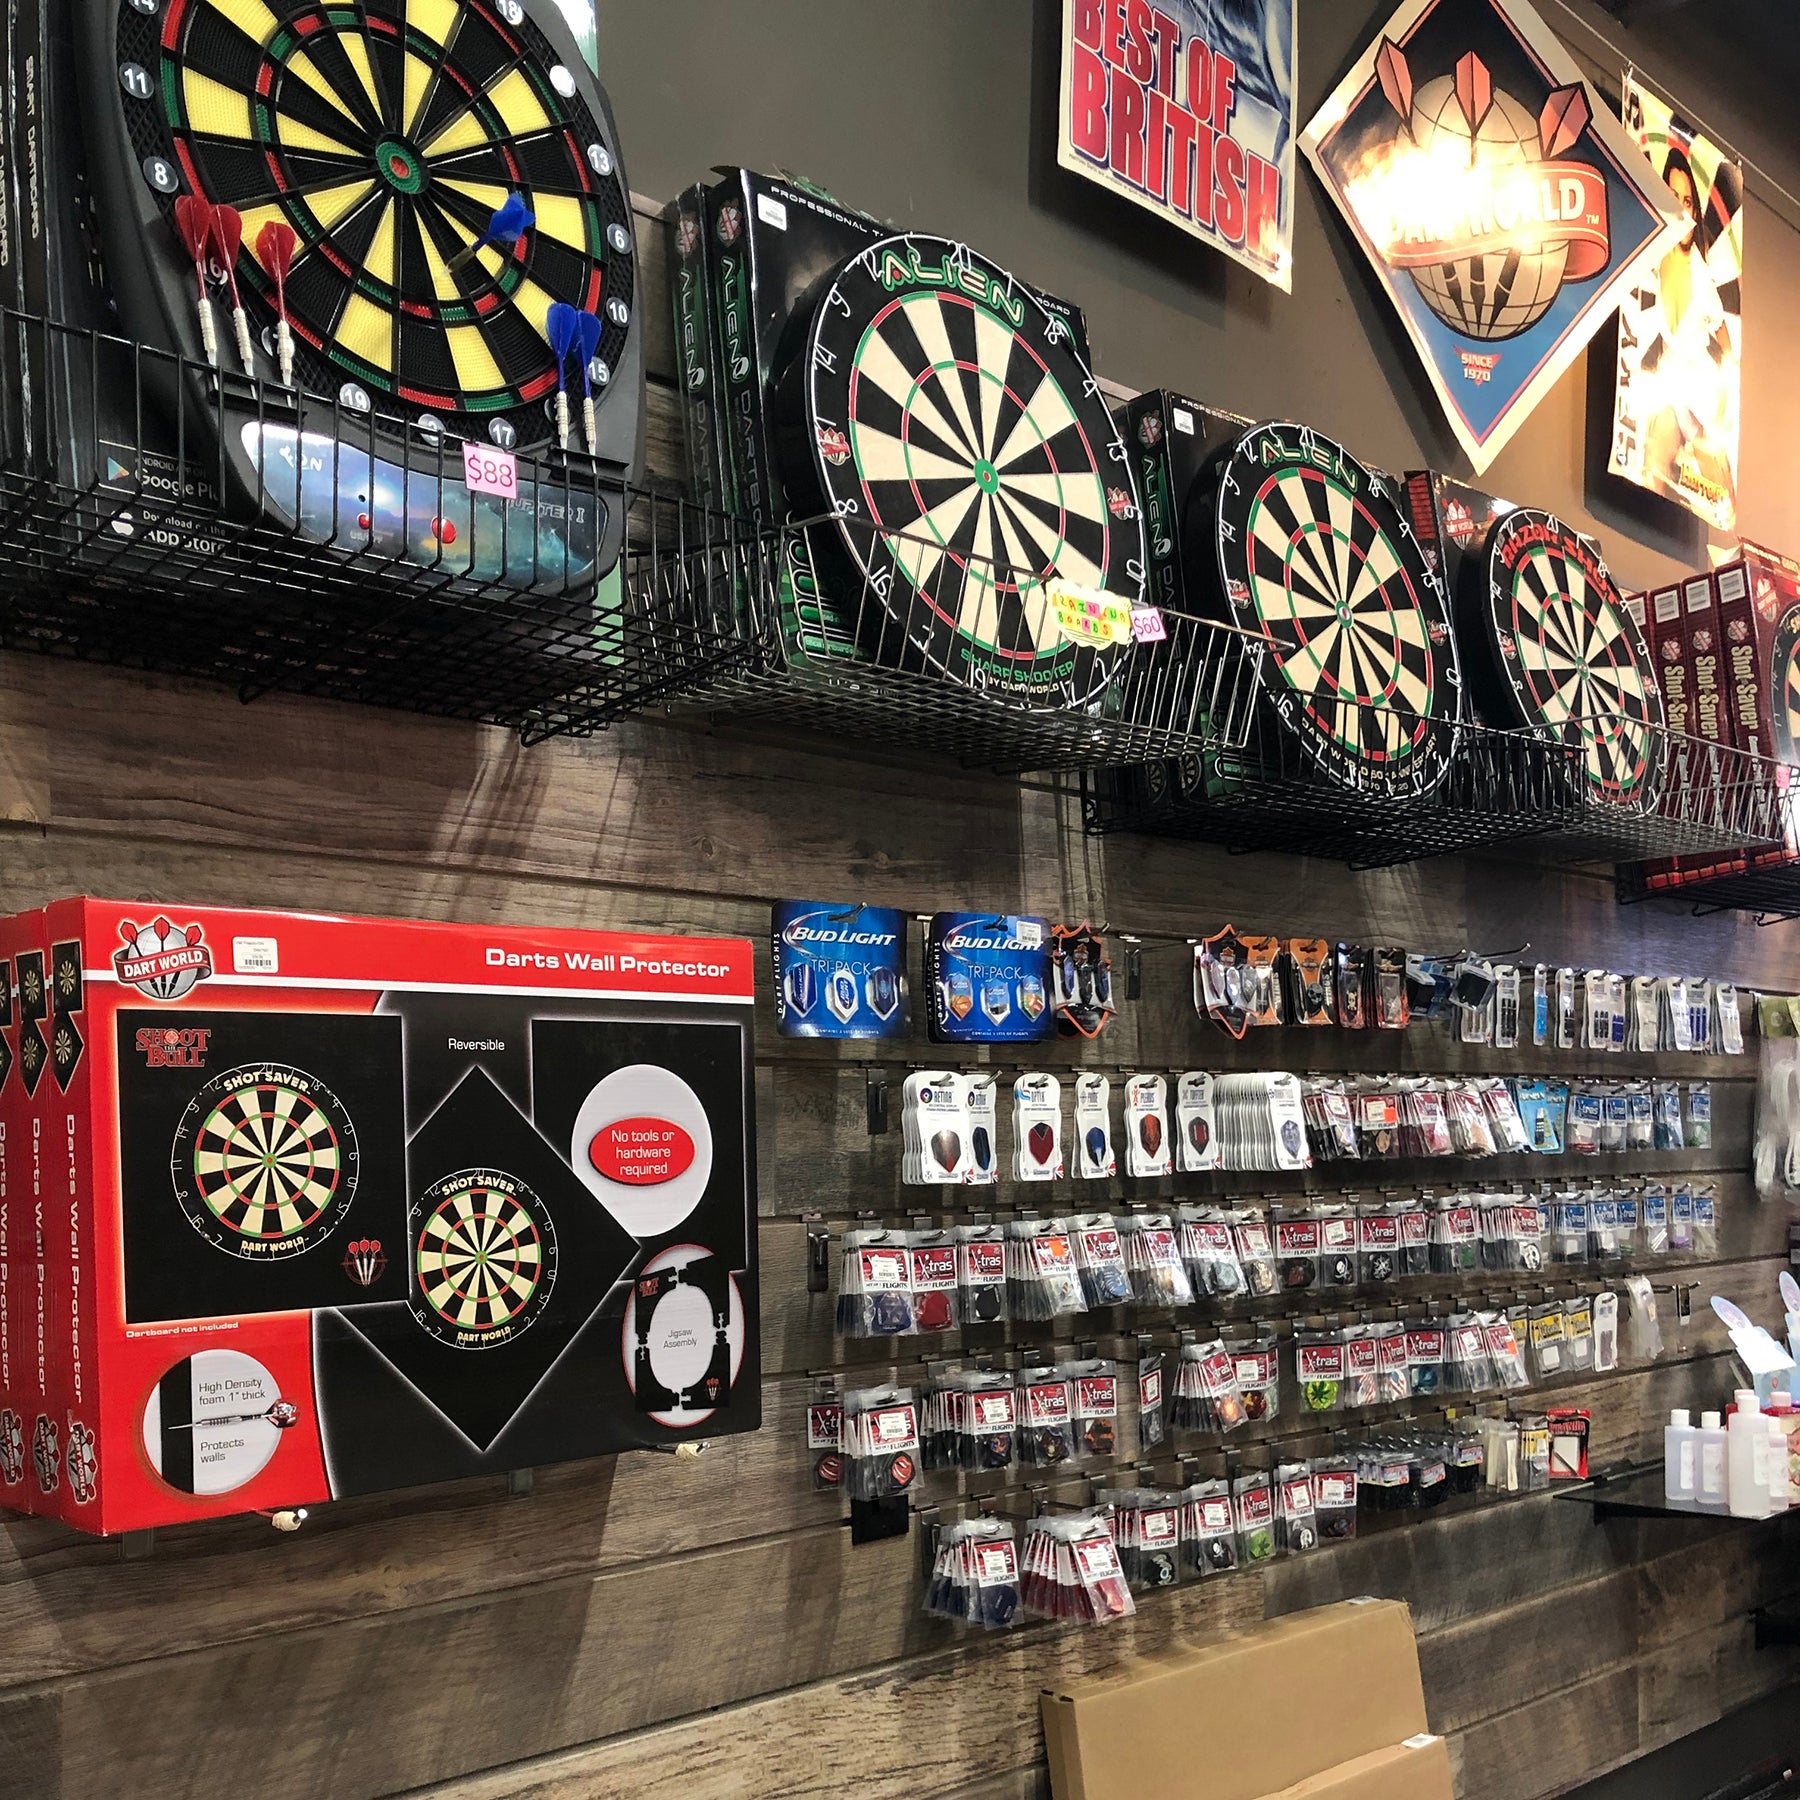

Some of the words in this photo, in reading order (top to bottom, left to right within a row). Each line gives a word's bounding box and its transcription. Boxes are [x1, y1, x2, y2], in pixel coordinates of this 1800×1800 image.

[1072, 0, 1180, 99] BEST
[1186, 36, 1236, 134] OF
[25, 55, 35, 116] SMART
[124, 68, 147, 94] 11
[592, 151, 609, 172] 13
[1071, 40, 1281, 265] BRITISH
[27, 125, 39, 239] DARTBOARD
[153, 162, 168, 185] 8
[770, 185, 868, 234] PROFESSIONAL
[614, 229, 625, 250] 6
[881, 249, 1024, 327] ALIEN
[609, 304, 627, 324] 10
[1461, 353, 1493, 369] SINCE
[1463, 367, 1491, 382] 1970
[344, 390, 368, 411] 19
[1180, 398, 1248, 428] PROFESSIONAL
[492, 423, 512, 446] 17
[468, 454, 513, 488] $88
[1259, 434, 1359, 494] ALIEN
[1133, 615, 1161, 638] $60
[791, 927, 837, 942] BUD
[837, 930, 896, 946] LIGHT
[950, 935, 992, 949] BUD
[123, 961, 156, 978] DART
[159, 950, 203, 971] WORLD
[485, 947, 560, 969] Darts
[564, 951, 615, 973] Wall
[620, 956, 730, 978] Protector
[773, 933, 781, 980] FLIGHTS
[811, 959, 872, 976] TRI-PACK
[967, 965, 1021, 980] TRI-PACK
[775, 985, 783, 1014] DART
[448, 1037, 505, 1052] Reversible
[146, 1047, 205, 1067] BULL
[223, 1071, 260, 1092] SHOT
[264, 1071, 309, 1093] SAVER
[612, 1129, 629, 1143] No
[631, 1129, 659, 1142] tools
[662, 1131, 675, 1141] or
[32, 1118, 41, 1195] Darts
[67, 1114, 76, 1195] Darts
[616, 1146, 671, 1159] hardware
[619, 1162, 668, 1178] required
[441, 1175, 474, 1196] SHOT
[477, 1175, 515, 1194] SAVER
[0, 1202, 8, 1257] Wall
[35, 1201, 44, 1257] Wall
[70, 1201, 79, 1259] Wall
[1282, 1225, 1315, 1247] X-tras
[1365, 1221, 1396, 1242] X-tras
[241, 1240, 267, 1252] DART
[269, 1236, 304, 1251] WORLD
[918, 1254, 953, 1279] X-tras
[971, 1249, 1001, 1273] X-tras
[882, 1281, 908, 1289] FLIGHTS
[932, 1280, 956, 1289] FLIGHTS
[0, 1263, 9, 1391] Protector
[37, 1263, 46, 1396] Protector
[71, 1265, 82, 1404] Protector
[126, 1326, 180, 1338] Dartboard
[181, 1325, 198, 1333] not
[199, 1321, 239, 1332] included
[457, 1331, 479, 1342] DART
[481, 1325, 511, 1341] WORLD
[668, 1328, 693, 1340] Jigsaw
[663, 1337, 698, 1349] Assembly
[1411, 1335, 1439, 1356] X-tras
[1307, 1351, 1340, 1371] X-tras
[199, 1382, 222, 1395] High
[225, 1378, 263, 1390] Density
[1084, 1382, 1113, 1406] X-tras
[199, 1395, 225, 1406] foam
[241, 1390, 266, 1401] thick
[1033, 1391, 1065, 1415] X-tras
[200, 1438, 245, 1452] Protects
[890, 1439, 915, 1450] FLIGHTS
[7, 1442, 15, 1478] WORLD
[42, 1448, 50, 1485] WORLD
[200, 1452, 226, 1464] walls
[77, 1463, 87, 1496] WORLD
[1154, 1538, 1177, 1547] FLIGHTS
[994, 1573, 1016, 1583] FLIGHTS
